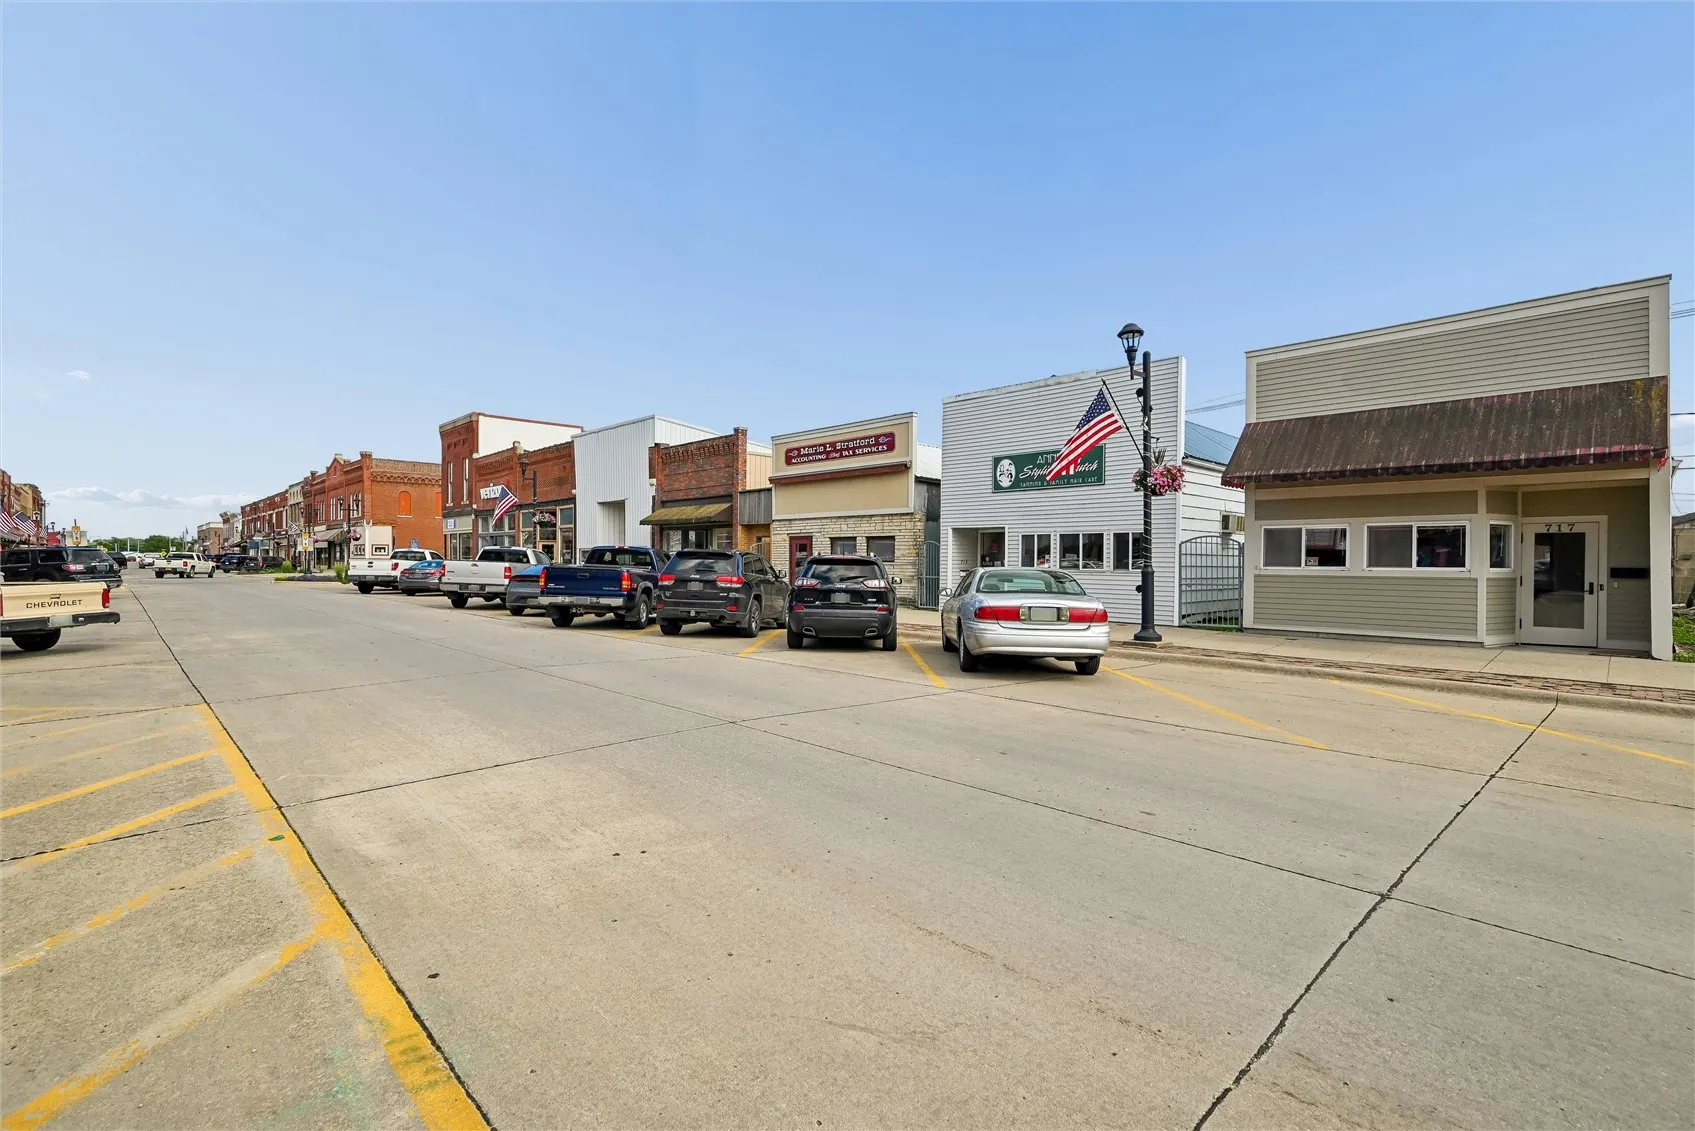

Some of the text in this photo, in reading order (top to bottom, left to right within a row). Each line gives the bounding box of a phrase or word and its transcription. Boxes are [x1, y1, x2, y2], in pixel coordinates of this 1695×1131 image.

[836, 438, 875, 449] Stratford
[791, 454, 826, 464] ACCOUNTING
[855, 445, 888, 455] SERVICES
[1544, 524, 1575, 532] 717
[26, 600, 83, 609] CHEVROLET
